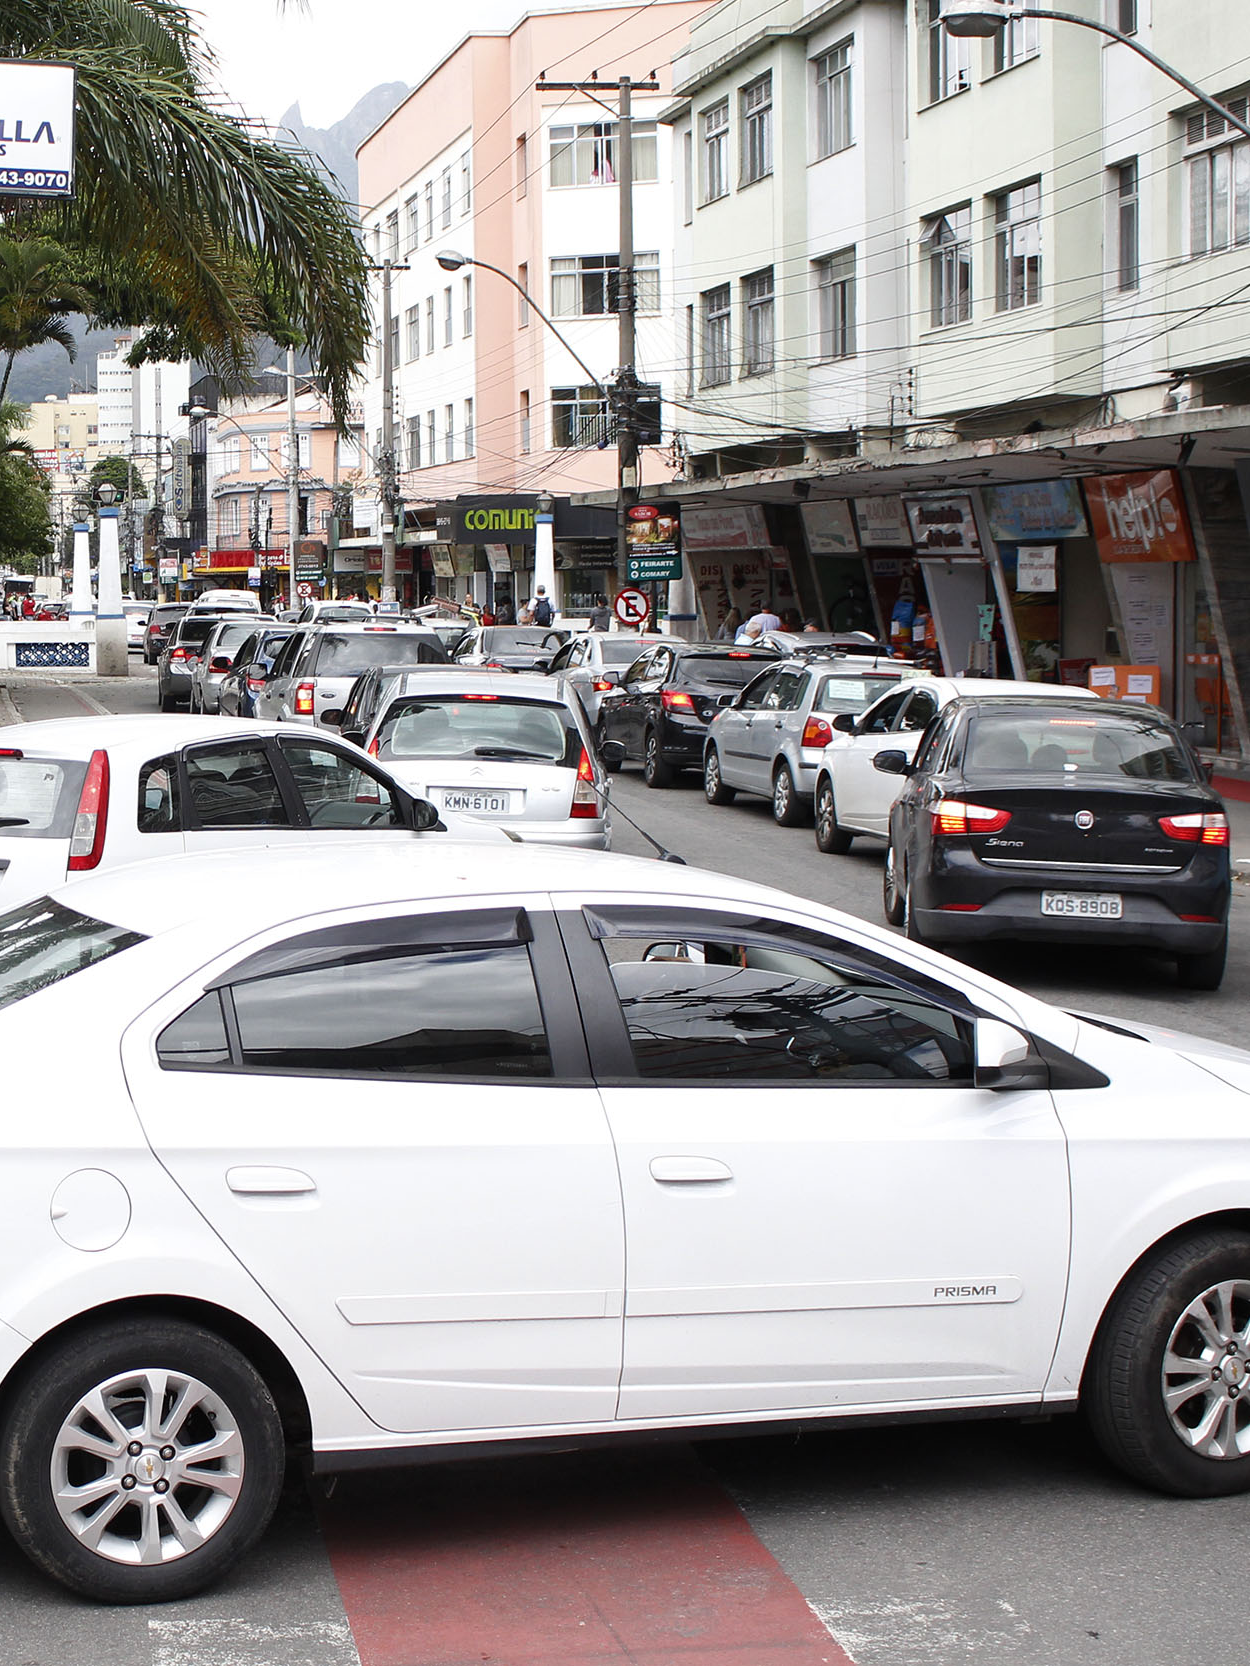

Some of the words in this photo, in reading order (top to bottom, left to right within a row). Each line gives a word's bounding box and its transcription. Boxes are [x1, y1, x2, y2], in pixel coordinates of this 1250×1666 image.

[464, 508, 540, 530] comuni
[985, 838, 1025, 847] Siena
[933, 1285, 997, 1298] PRISMA
